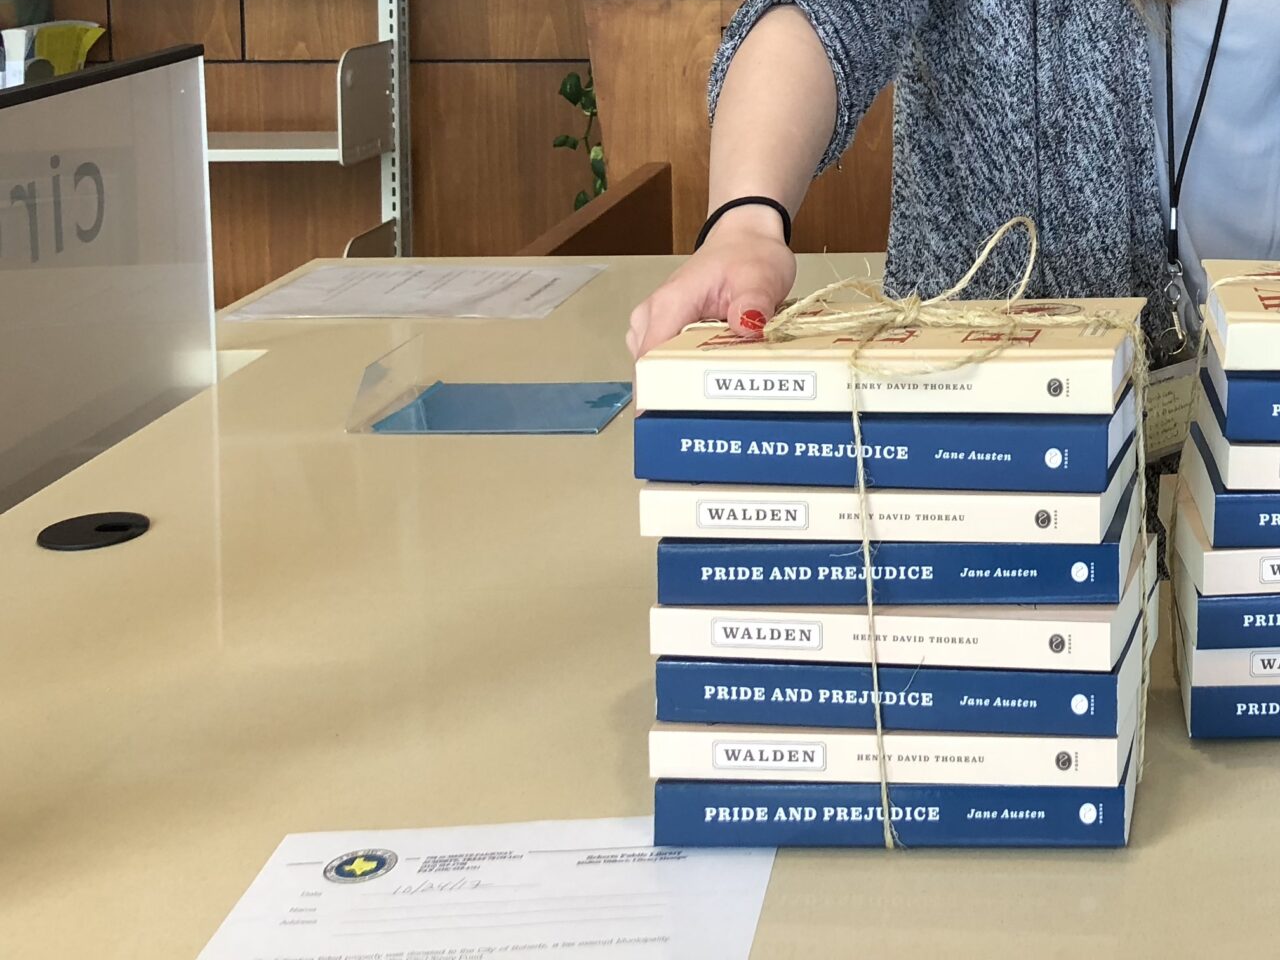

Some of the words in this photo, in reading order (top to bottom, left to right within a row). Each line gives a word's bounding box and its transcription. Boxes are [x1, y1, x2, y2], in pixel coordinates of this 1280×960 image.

[714, 378, 806, 392] WALDEN
[886, 382, 919, 390] DAVID
[922, 383, 973, 391] THOREAU
[680, 438, 742, 454] PRIDE
[746, 440, 789, 456] AND
[934, 449, 965, 460] Jane
[969, 450, 1012, 462] Austen
[707, 508, 798, 522] WALDEN
[838, 511, 874, 521] HENY
[878, 513, 911, 521] DAVID
[915, 513, 965, 522] THOREAU
[700, 566, 764, 581] PRIDE
[768, 566, 812, 581] AND
[959, 567, 991, 578] Jane
[993, 567, 1038, 578] Austen
[722, 626, 812, 642] WALDEN
[892, 635, 925, 643] DAVID
[928, 636, 979, 645] THOREAU
[703, 685, 766, 701] PRIDE
[770, 687, 813, 703] AND
[959, 695, 991, 707] Jane
[992, 696, 1038, 708] Austen
[724, 748, 816, 763] WALDEN
[856, 753, 893, 763] HENY
[897, 754, 930, 763] DAVID
[934, 755, 985, 763] THOREAU
[704, 806, 769, 822] PRIDE
[773, 806, 817, 822] AND
[966, 808, 998, 819] Jane
[999, 808, 1046, 819] Austen
